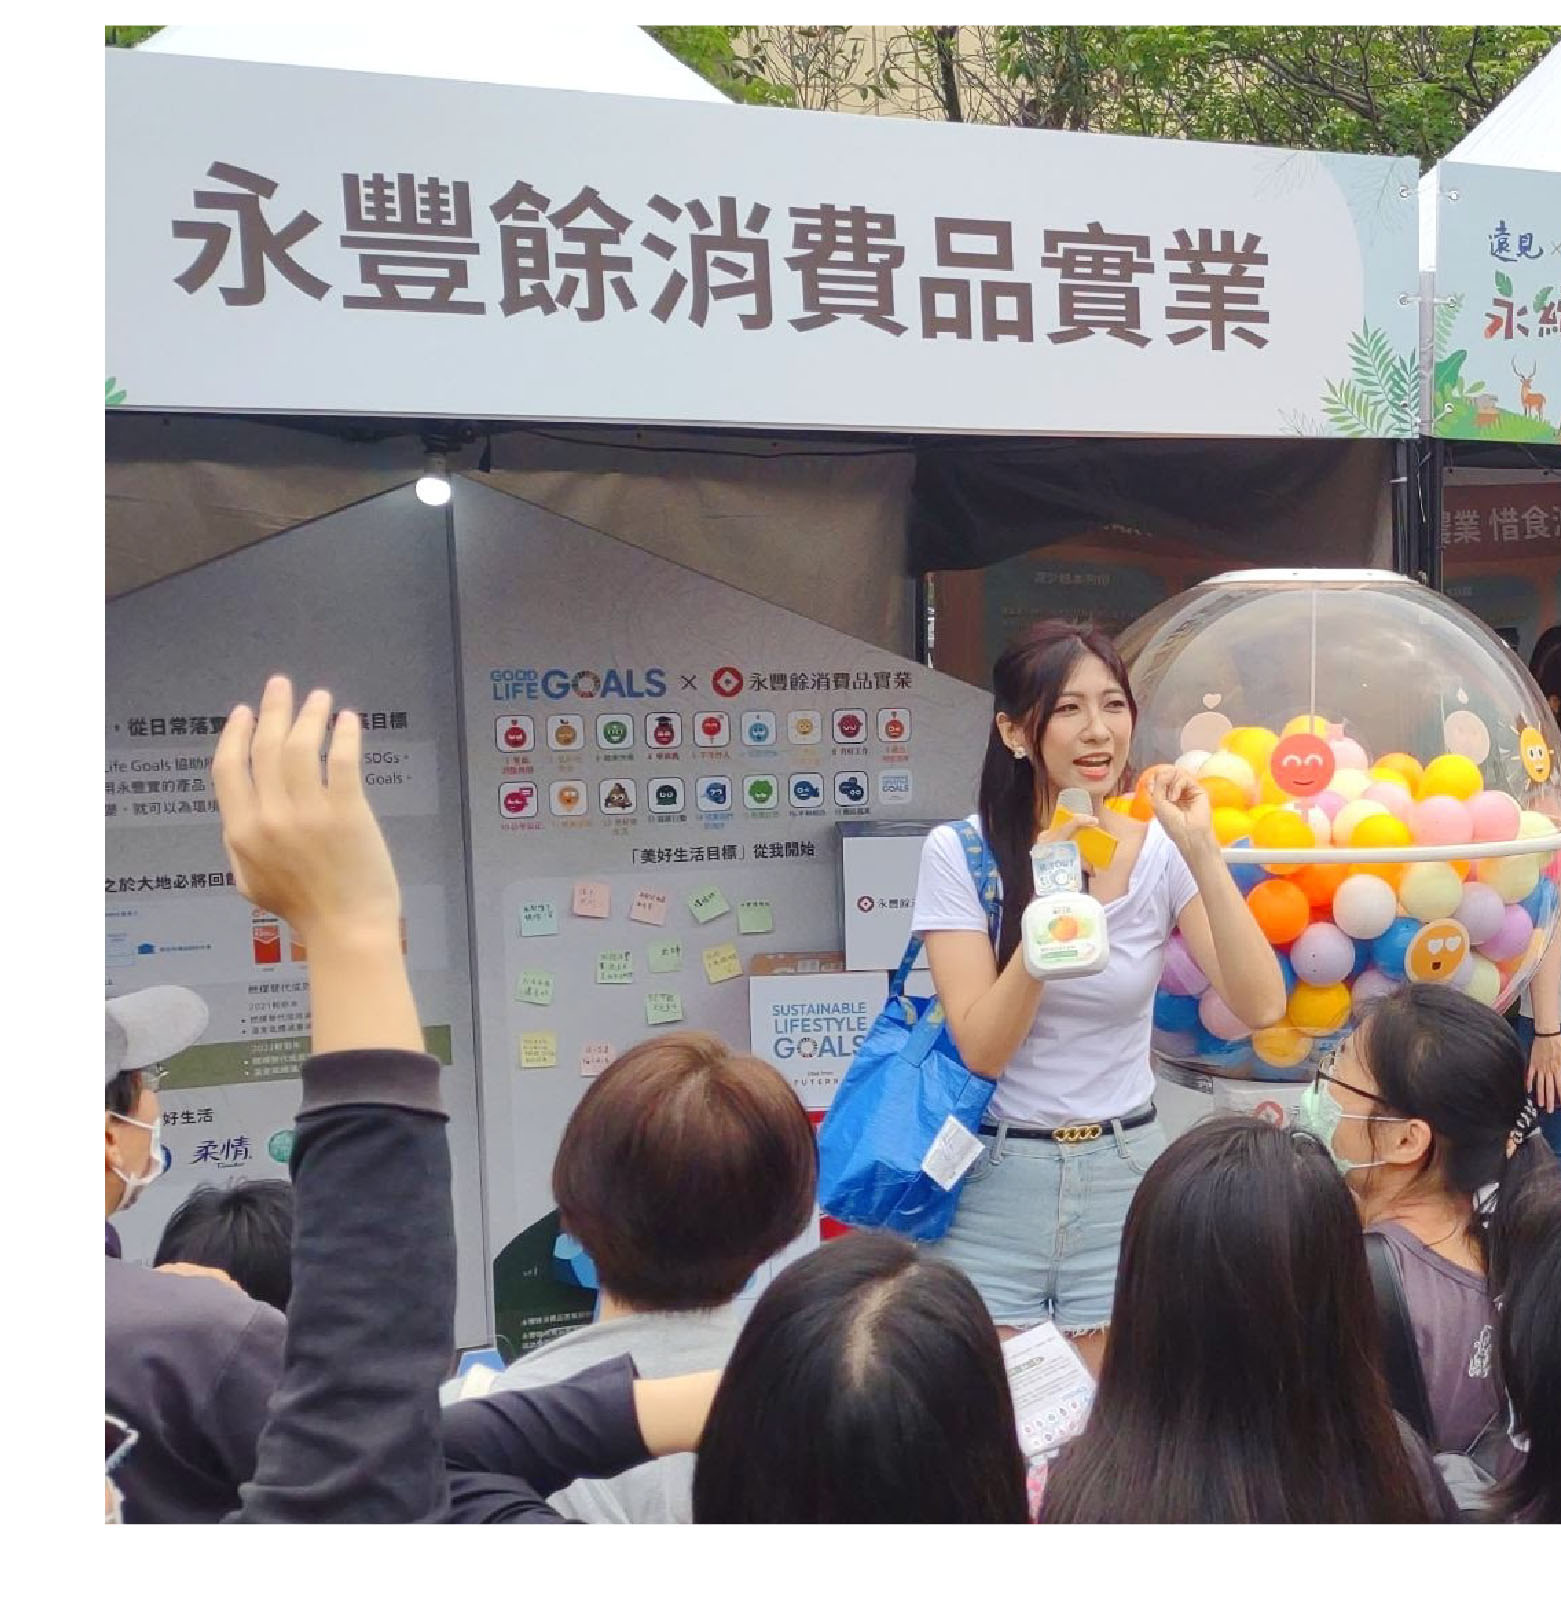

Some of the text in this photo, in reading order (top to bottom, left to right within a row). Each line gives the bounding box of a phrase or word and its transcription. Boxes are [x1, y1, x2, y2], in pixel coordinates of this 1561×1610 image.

[1488, 220, 1543, 262] 遠見
[172, 160, 1270, 351] 永豐餘消費品實業
[490, 671, 538, 681] GOOD
[541, 668, 667, 700] GOALS
[750, 671, 912, 691] 永豐餘消費品實業
[492, 683, 538, 700] LIFE
[772, 1002, 867, 1017] SUSTAINABLE
[775, 1017, 868, 1034] LIFESTYLE
[188, 1135, 252, 1165] 柔情
